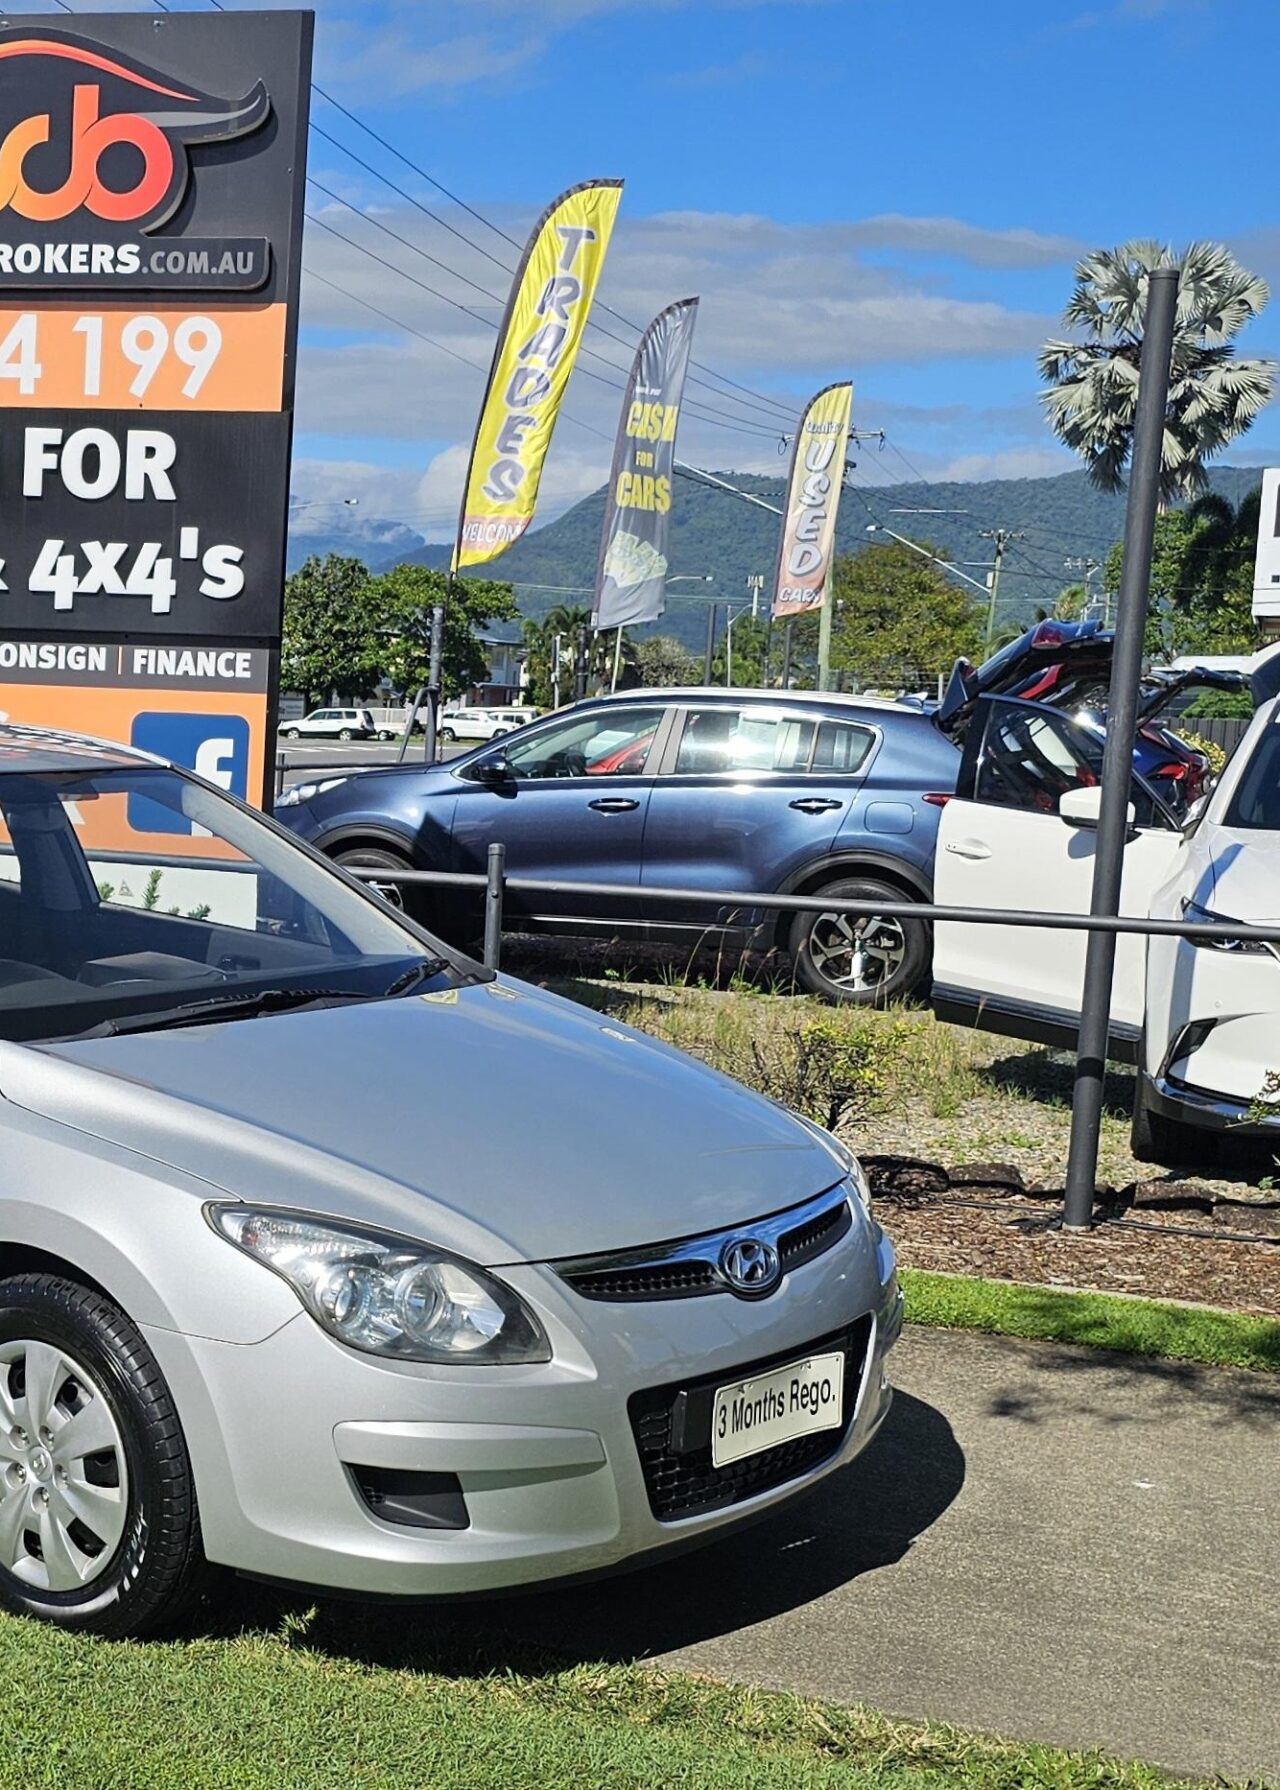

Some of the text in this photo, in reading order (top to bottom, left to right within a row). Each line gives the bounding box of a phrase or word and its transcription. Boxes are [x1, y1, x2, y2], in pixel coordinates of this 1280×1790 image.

[72, 315, 222, 400] 199
[482, 226, 596, 503] TRADES
[23, 427, 176, 501] FOR
[636, 450, 654, 468] FOR
[462, 521, 526, 543] WELCOM
[788, 439, 836, 577] USED
[132, 649, 252, 679] FINANCE
[718, 1378, 836, 1438] 3 Months Rego.
